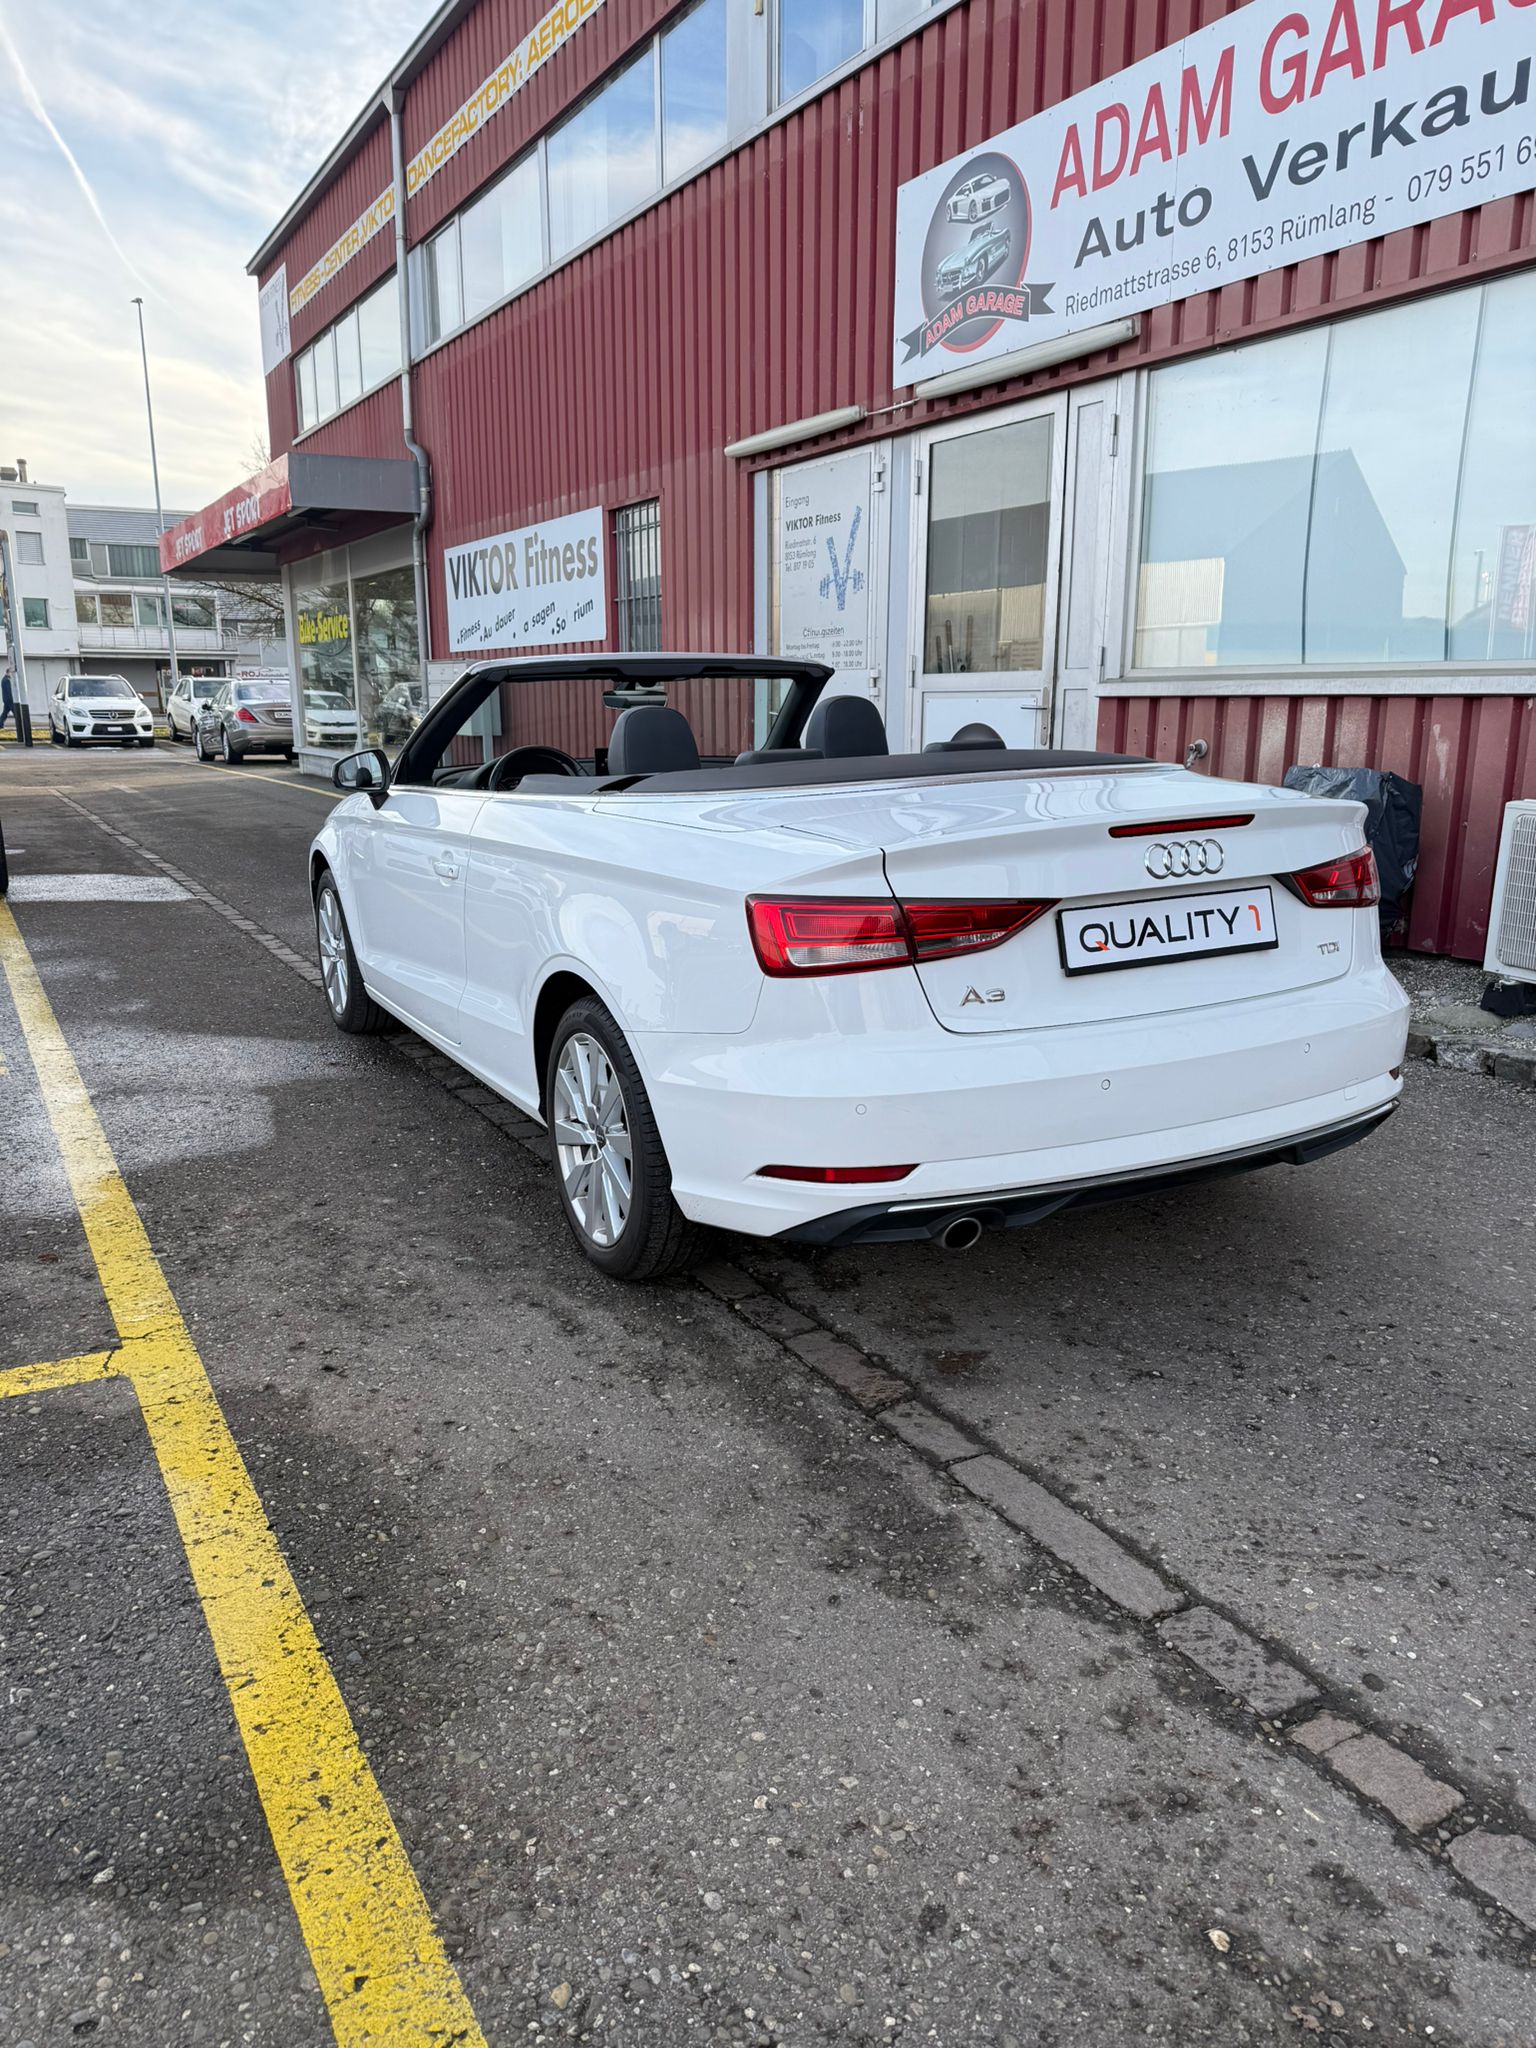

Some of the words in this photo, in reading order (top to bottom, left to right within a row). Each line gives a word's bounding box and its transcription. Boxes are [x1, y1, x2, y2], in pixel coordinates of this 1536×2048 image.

[1050, 44, 1235, 210] ADAM
[1259, 0, 1536, 115] GAR
[1065, 256, 1201, 317] Riedmattstrasse
[1206, 246, 1221, 271] 6,
[1227, 226, 1274, 263] 8153
[1281, 195, 1377, 245] Rümlang
[1408, 165, 1452, 202] 079
[1460, 144, 1505, 185] 551
[1517, 135, 1536, 165] 6
[1074, 186, 1213, 270] Auto
[925, 302, 963, 349] ADAM
[966, 292, 1025, 316] GARAGE
[235, 495, 260, 529] SPORT
[785, 495, 810, 509] Eingang
[785, 516, 814, 532] VIKTOR
[815, 512, 842, 526] Fitness
[449, 541, 519, 600] VIKTOR
[524, 531, 599, 588] Fitness
[460, 619, 481, 644] Fitness
[1079, 905, 1240, 953] QUALITY
[1247, 904, 1262, 932] 1
[960, 984, 1007, 1007] A3
